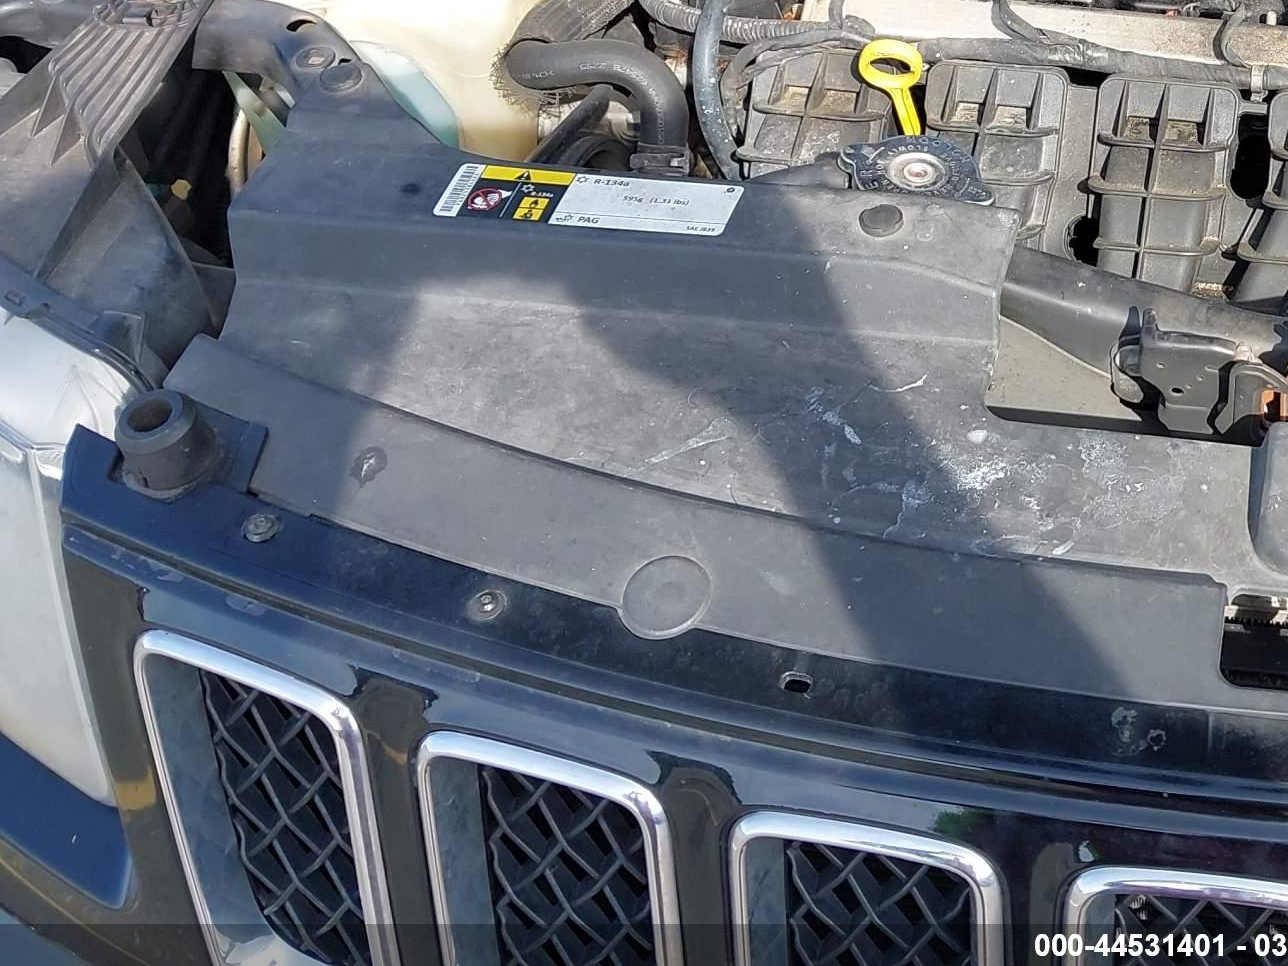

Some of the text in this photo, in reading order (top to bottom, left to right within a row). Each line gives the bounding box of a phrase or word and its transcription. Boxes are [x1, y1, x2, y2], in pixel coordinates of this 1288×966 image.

[593, 178, 630, 187] R-134a
[673, 198, 690, 206] lbs)
[577, 216, 600, 224] PAG
